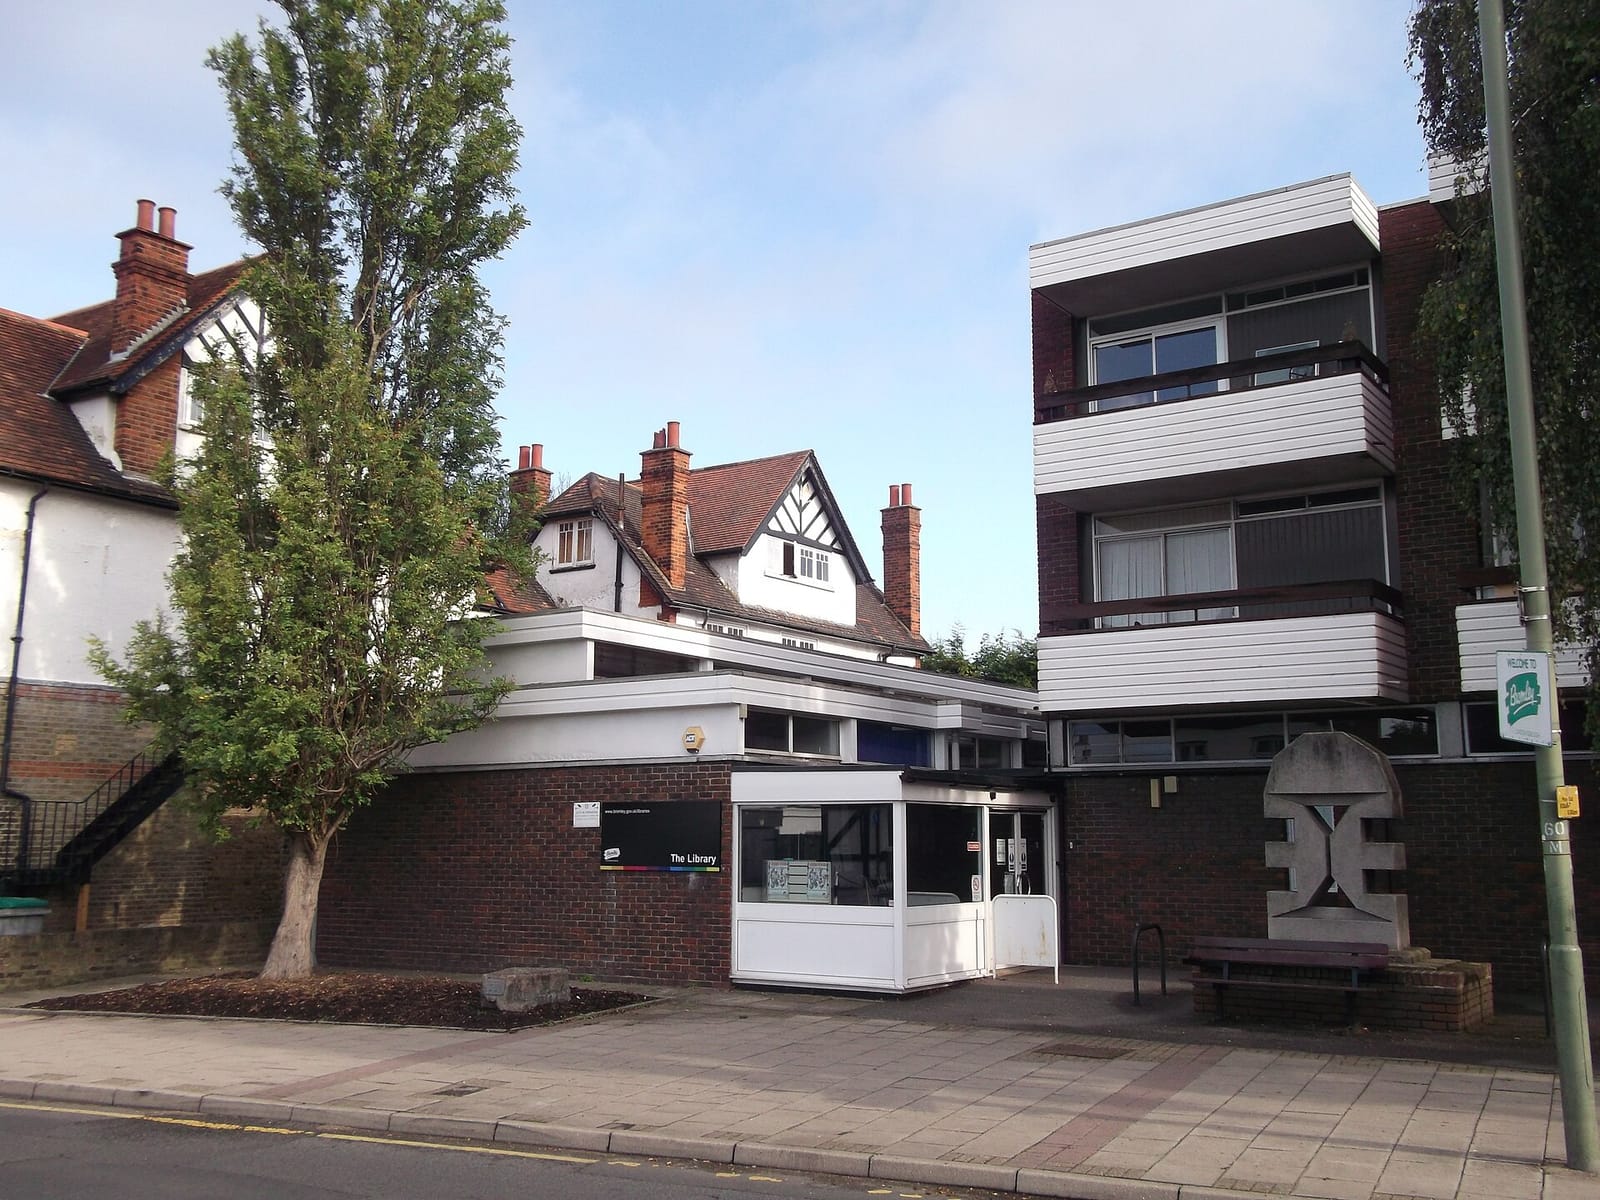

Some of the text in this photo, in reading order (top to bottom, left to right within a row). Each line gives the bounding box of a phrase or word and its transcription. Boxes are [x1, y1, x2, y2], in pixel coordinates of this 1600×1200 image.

[1507, 658, 1537, 669] WELCOME TO
[1510, 680, 1536, 706] Bromley
[670, 853, 717, 866] The Library
